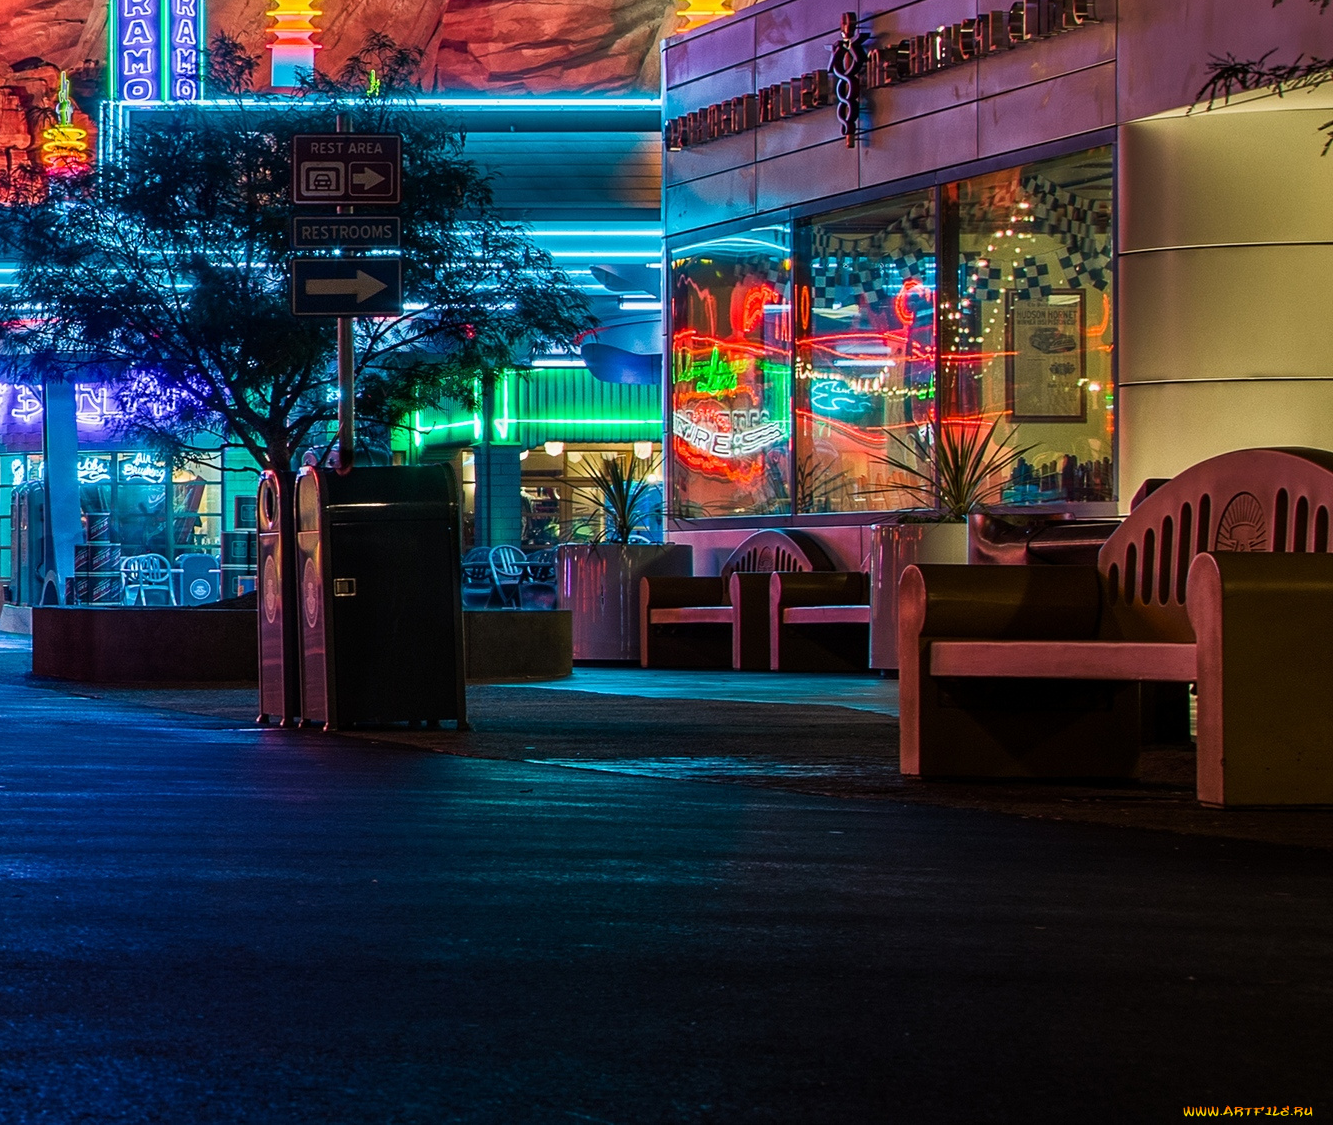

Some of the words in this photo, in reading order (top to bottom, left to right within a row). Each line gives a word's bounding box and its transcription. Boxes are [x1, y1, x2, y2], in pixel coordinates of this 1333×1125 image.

[310, 141, 343, 155] REST
[348, 141, 383, 155] AREA
[302, 223, 393, 240] RESTROOMS
